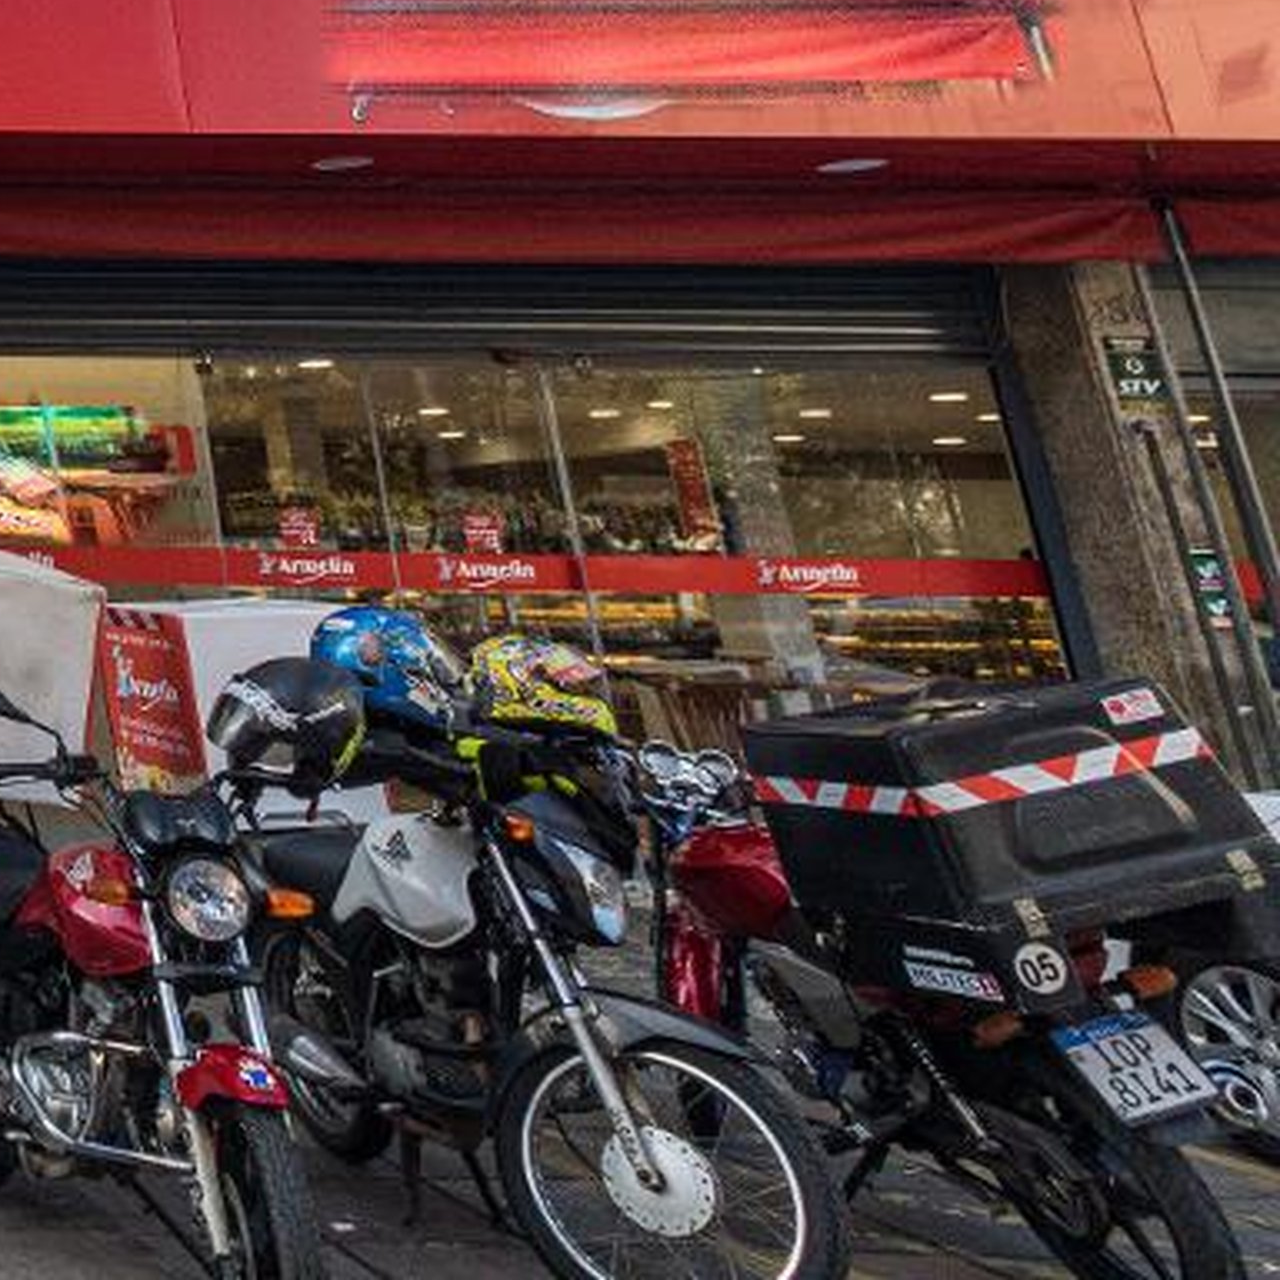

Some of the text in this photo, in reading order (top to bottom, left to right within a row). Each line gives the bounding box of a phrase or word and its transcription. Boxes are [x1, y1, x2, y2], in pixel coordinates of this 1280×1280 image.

[1119, 379, 1161, 396] STV
[1019, 952, 1060, 988] 05
[1108, 1062, 1201, 1110] 8141
